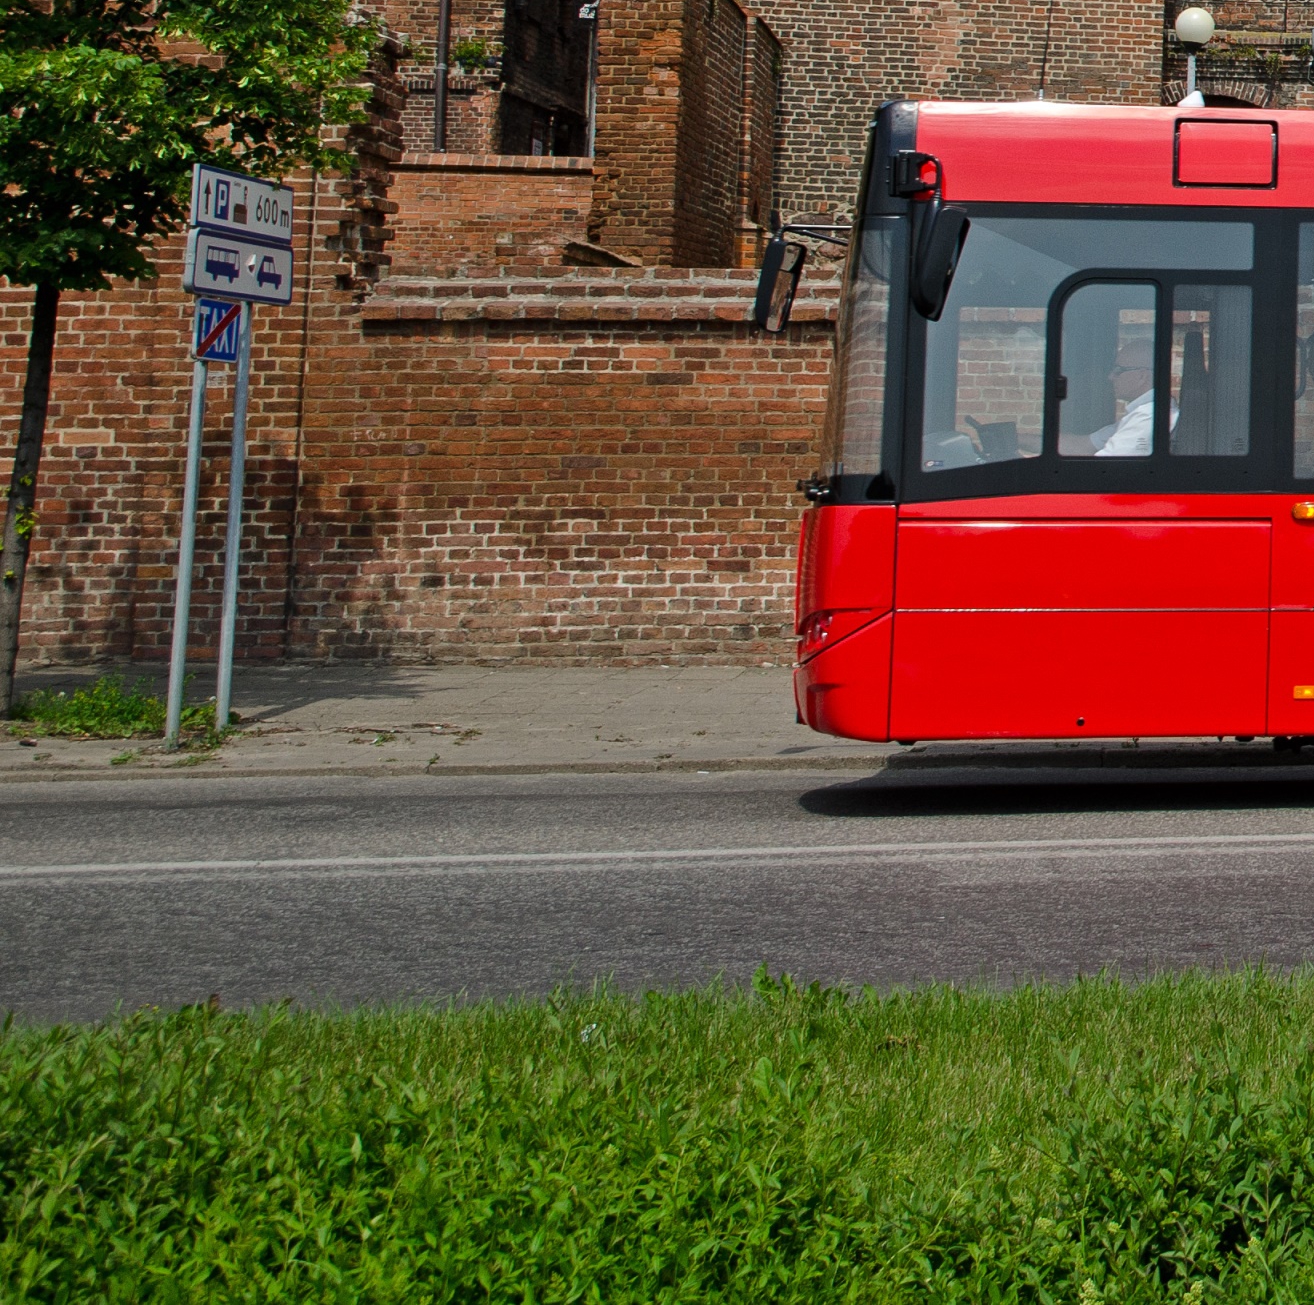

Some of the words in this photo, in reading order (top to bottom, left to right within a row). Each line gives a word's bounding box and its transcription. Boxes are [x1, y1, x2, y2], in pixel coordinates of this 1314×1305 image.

[216, 182, 229, 215] P
[256, 195, 278, 225] 600
[280, 209, 290, 229] m
[199, 305, 239, 355] TAXI
